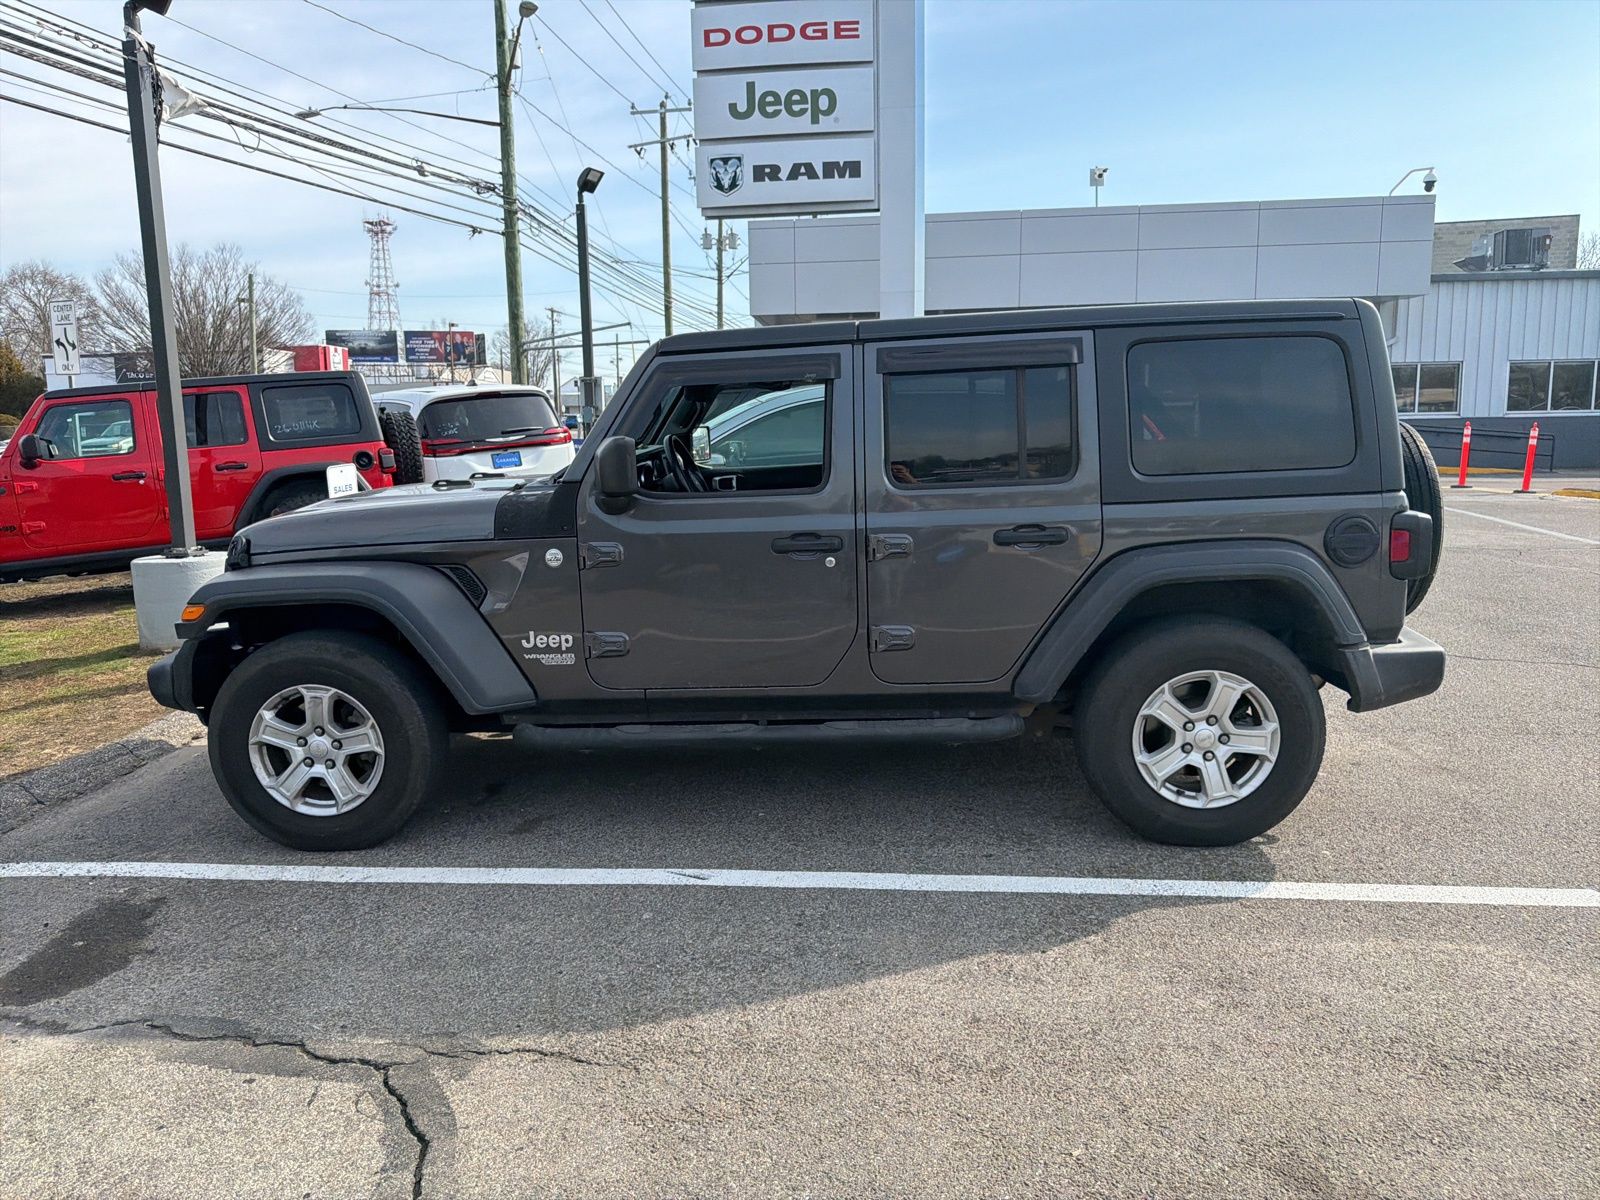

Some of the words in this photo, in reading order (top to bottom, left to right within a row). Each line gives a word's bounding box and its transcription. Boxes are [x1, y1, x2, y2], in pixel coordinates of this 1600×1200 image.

[703, 20, 860, 47] DODGE
[728, 80, 837, 124] Jeep
[752, 160, 862, 183] RAM
[53, 304, 72, 312] CENTER
[57, 313, 71, 322] LANE
[62, 363, 74, 371] ONLY
[333, 483, 353, 494] SALES
[521, 630, 574, 651] Jeep
